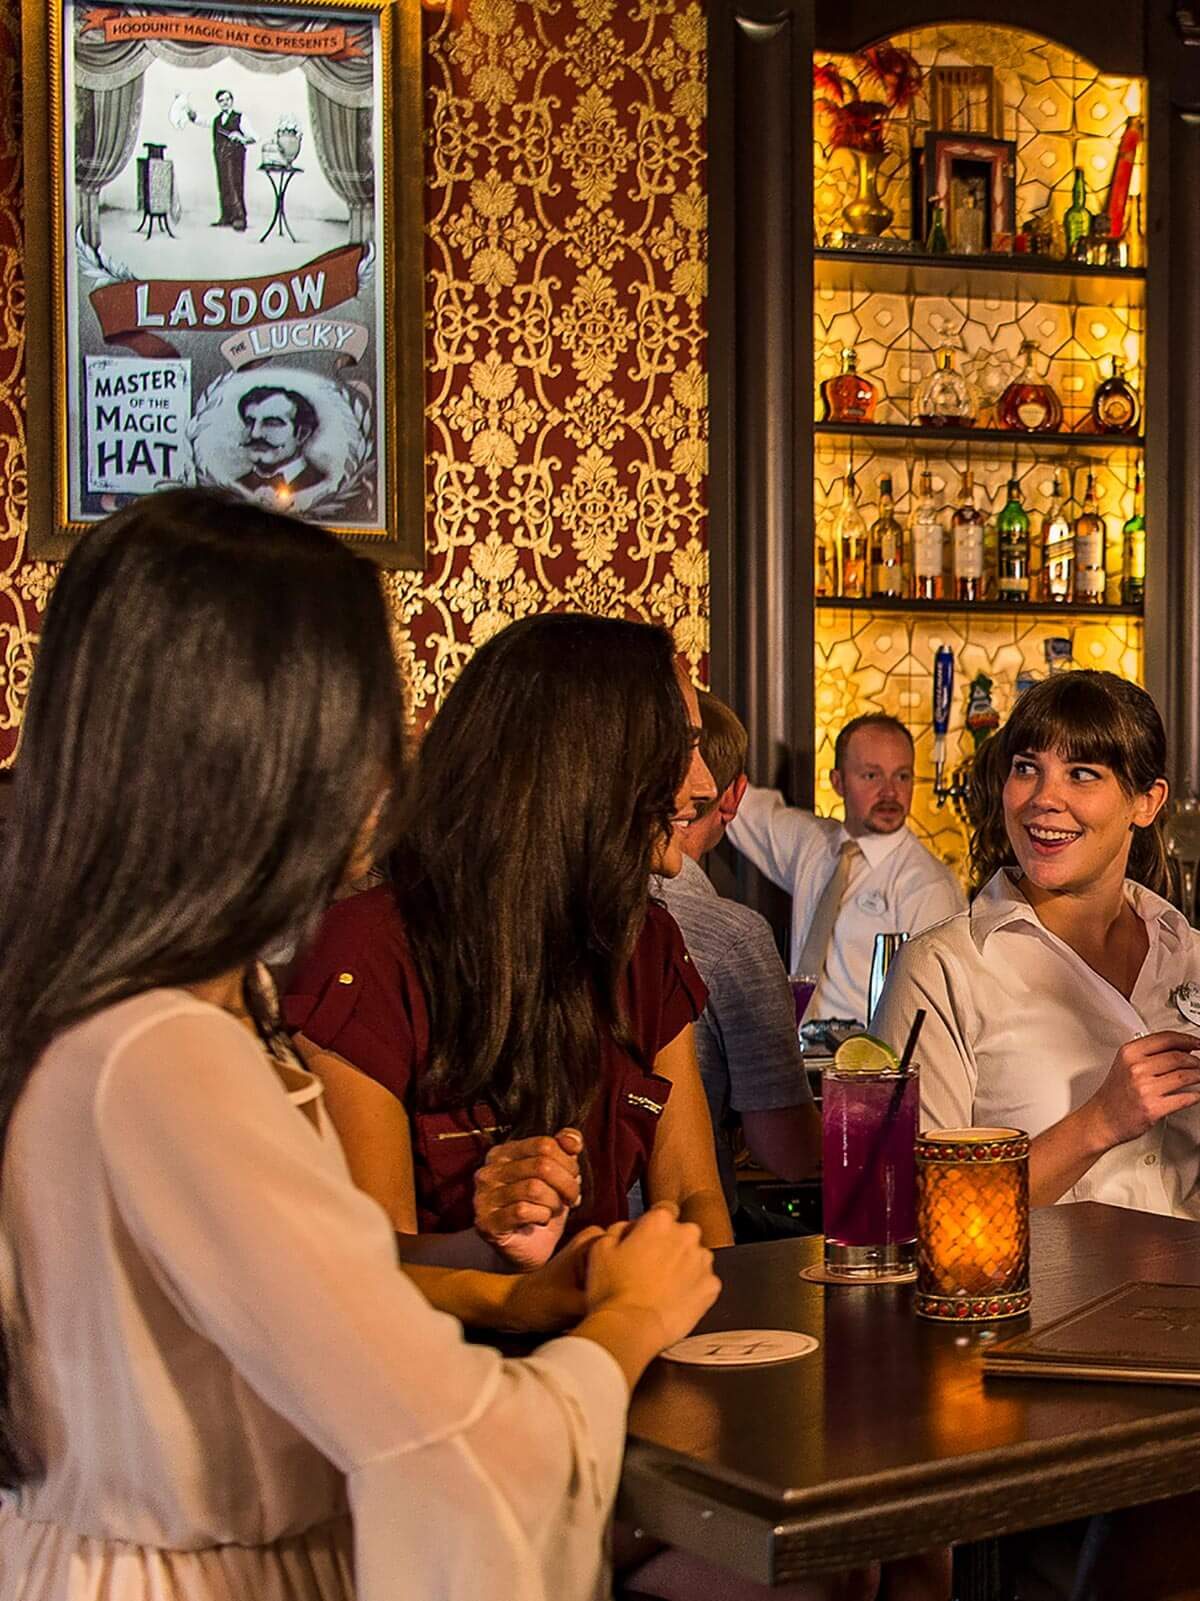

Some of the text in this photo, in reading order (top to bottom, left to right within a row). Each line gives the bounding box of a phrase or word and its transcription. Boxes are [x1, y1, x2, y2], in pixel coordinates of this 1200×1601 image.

[112, 21, 338, 48] HOODUNIT MAGIC HAT CO. PRESENTS
[135, 271, 326, 327] LASDOW
[229, 324, 354, 356] THE LUCKY
[95, 370, 177, 398] MASTER
[129, 398, 170, 409] OF THE
[96, 405, 178, 434] MAGIC
[97, 439, 178, 479] HAT
